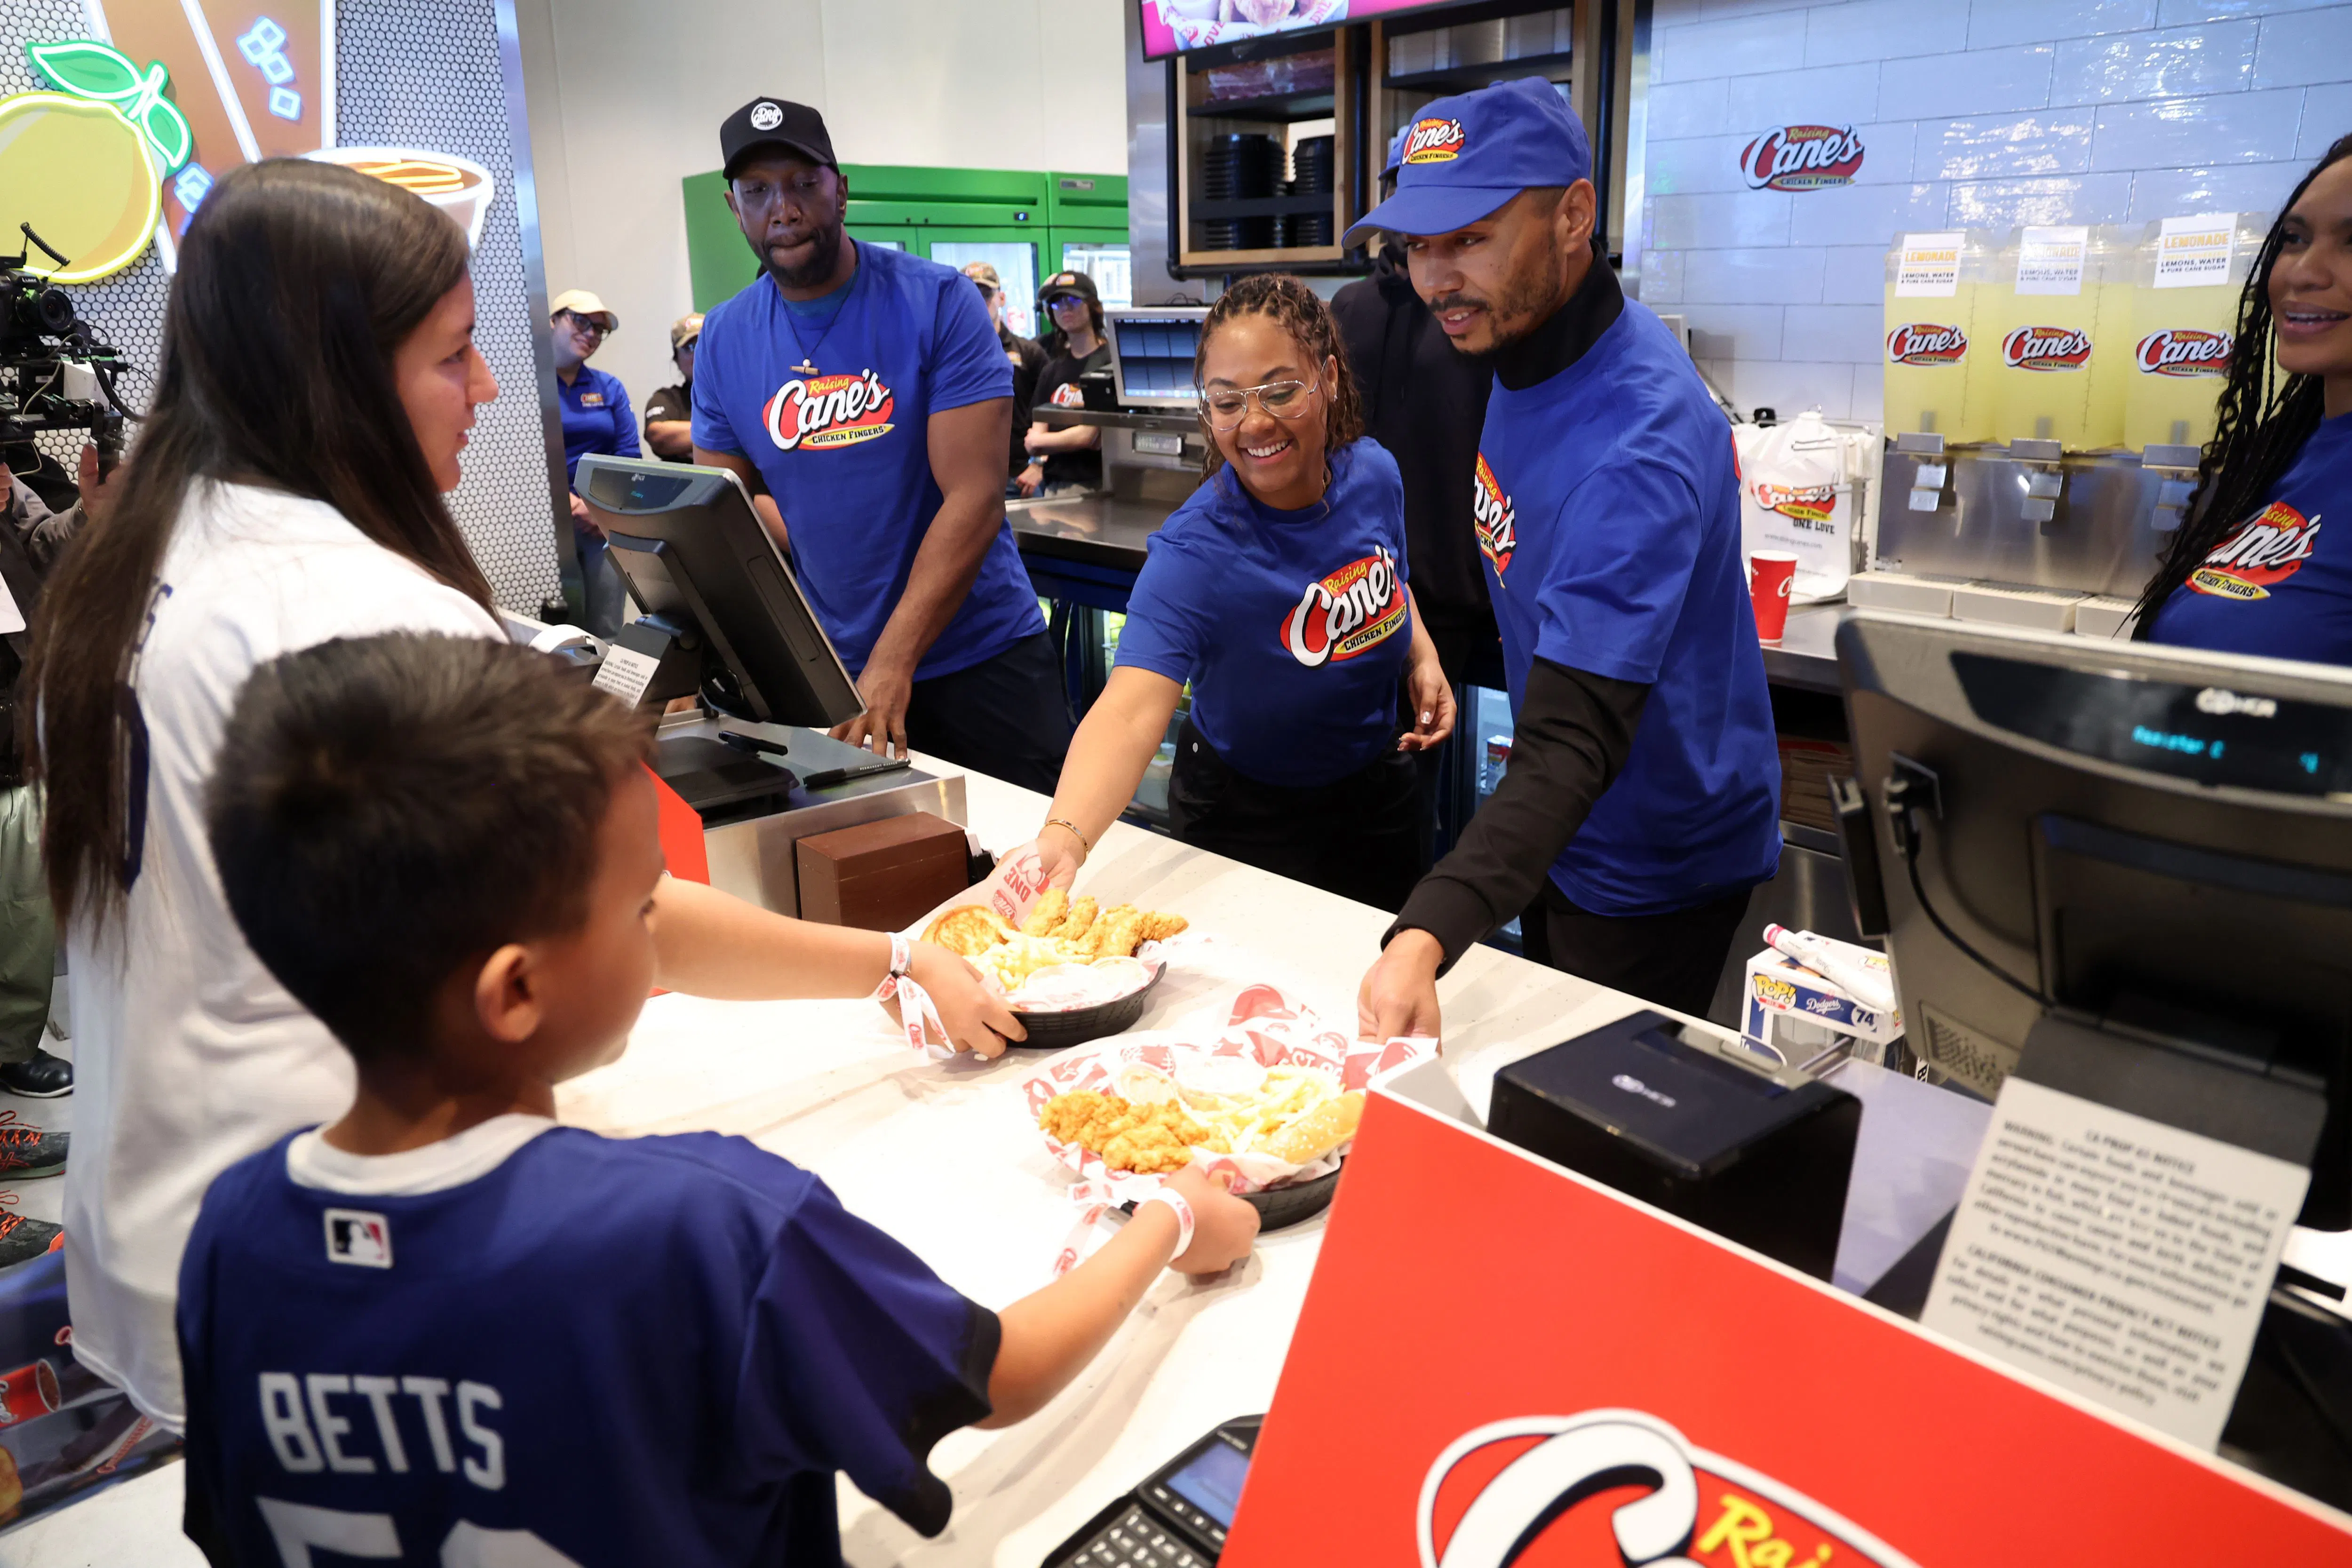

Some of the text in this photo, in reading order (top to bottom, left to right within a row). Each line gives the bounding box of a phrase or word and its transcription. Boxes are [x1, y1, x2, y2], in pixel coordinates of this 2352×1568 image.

[1401, 118, 1464, 165] Cane's
[1788, 127, 1830, 141] Raising
[1744, 124, 1866, 190] Cane's
[1814, 176, 1849, 185] FINGERS
[2164, 232, 2230, 249] LEMONADE
[1905, 249, 1958, 262] LEMONADE
[2161, 259, 2197, 268] LEMONS,
[1888, 323, 1968, 363] Cane's
[2003, 326, 2091, 367] Cane's
[2034, 328, 2065, 338] Raising
[2173, 331, 2208, 342] Raising
[2138, 329, 2234, 373] Cane's
[809, 376, 850, 395] Raising
[768, 367, 891, 450] Cane's
[812, 426, 884, 444] CHICKEN FINGERS
[1476, 456, 1497, 501] Raising
[1793, 519, 1835, 534] ONE LOVE
[1324, 562, 1368, 596] Raising
[2195, 570, 2256, 597] CHICKEN FINGERS
[1289, 544, 1396, 667] Cane's
[1343, 607, 1407, 651] CHICKEN FINGERS
[1003, 866, 1031, 903] ONE
[1753, 974, 1797, 1004] POP!
[1806, 997, 1842, 1015] Dodgers
[1857, 1009, 1875, 1027] 74
[258, 1371, 507, 1491] BETTS
